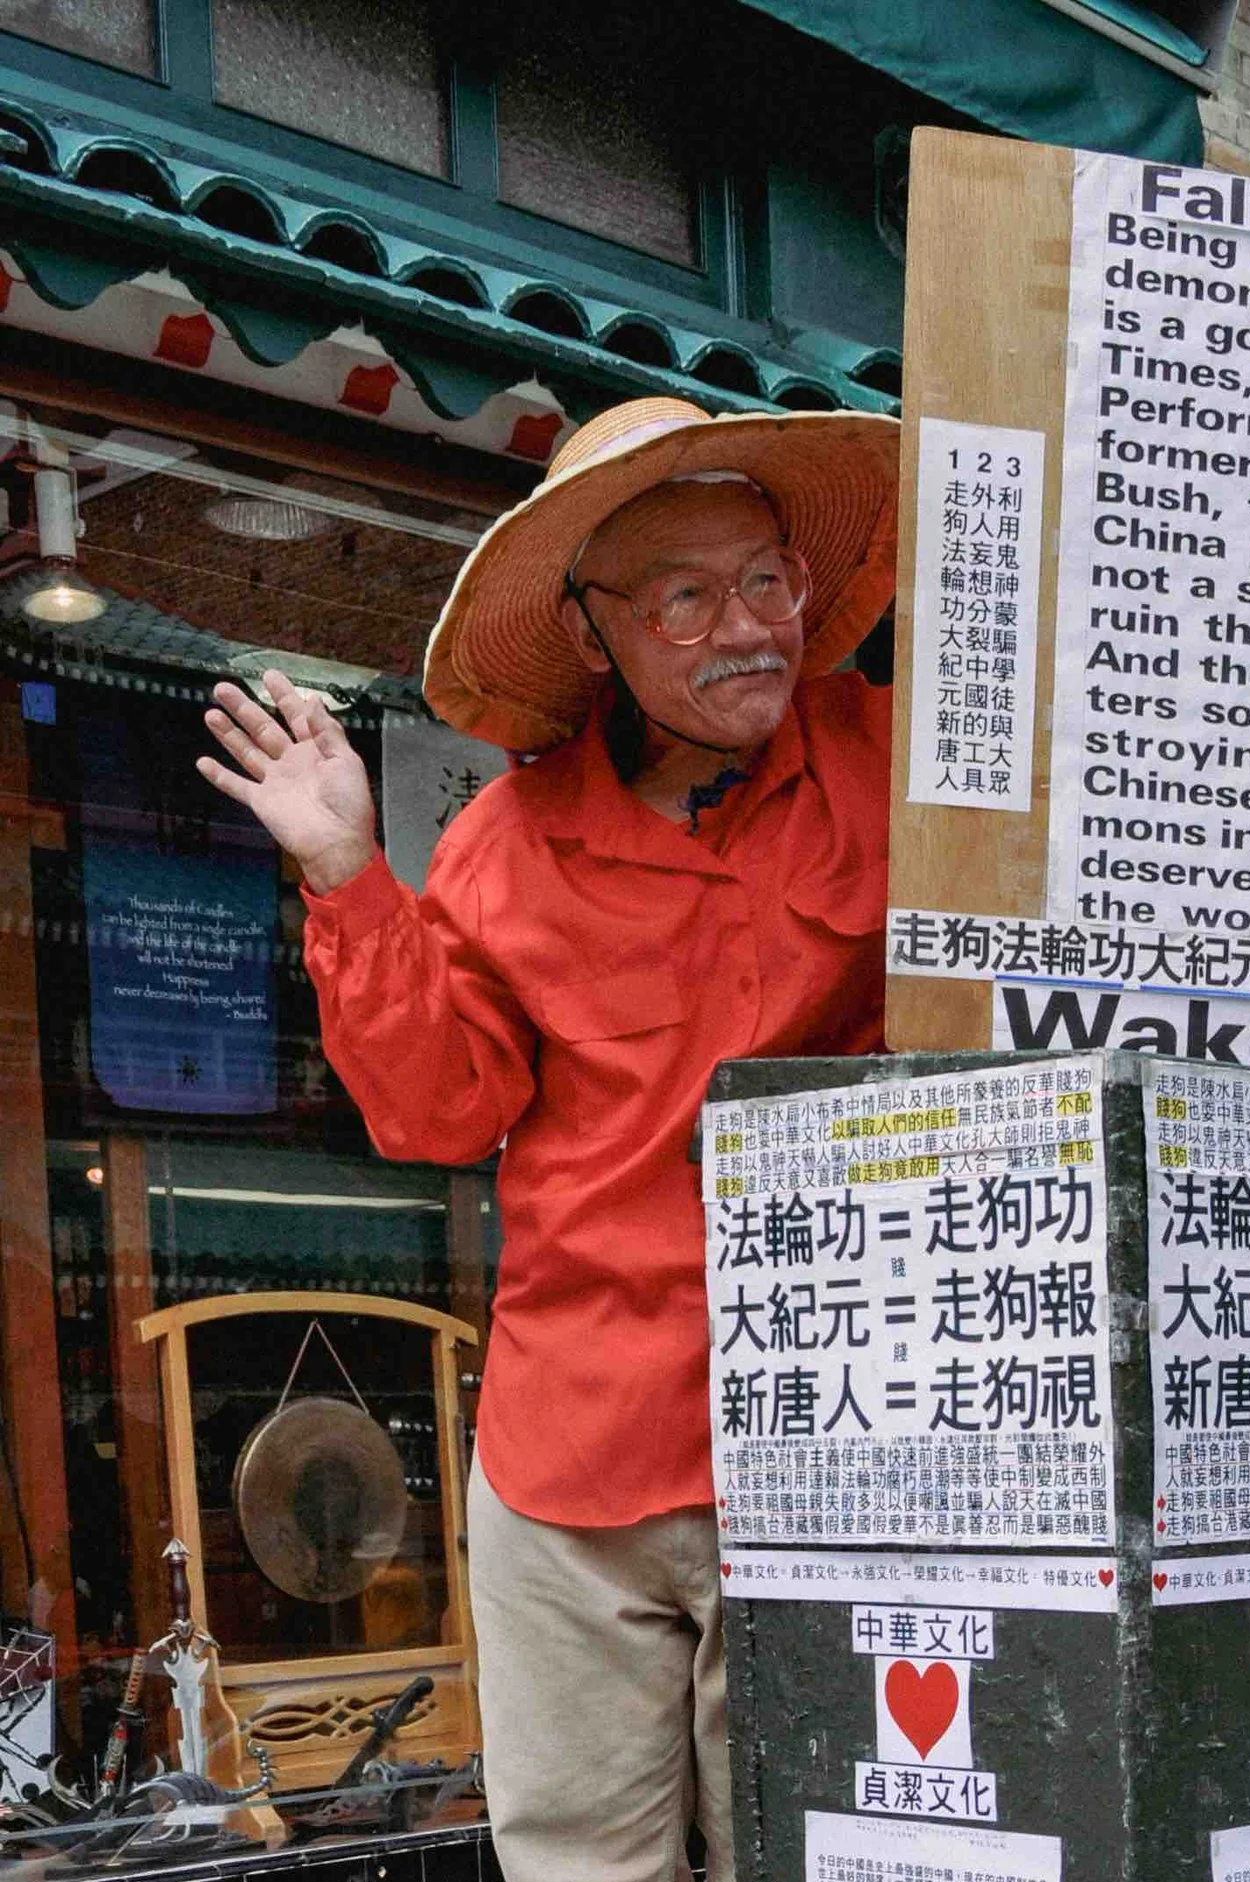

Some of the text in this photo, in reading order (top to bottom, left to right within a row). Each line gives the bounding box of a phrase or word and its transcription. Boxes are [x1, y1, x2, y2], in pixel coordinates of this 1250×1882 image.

[1107, 211, 1237, 269] Being
[1093, 513, 1226, 559] China
[1085, 639, 1179, 678] And
[1077, 889, 1156, 923] the
[856, 1608, 990, 1656] 中華文化
